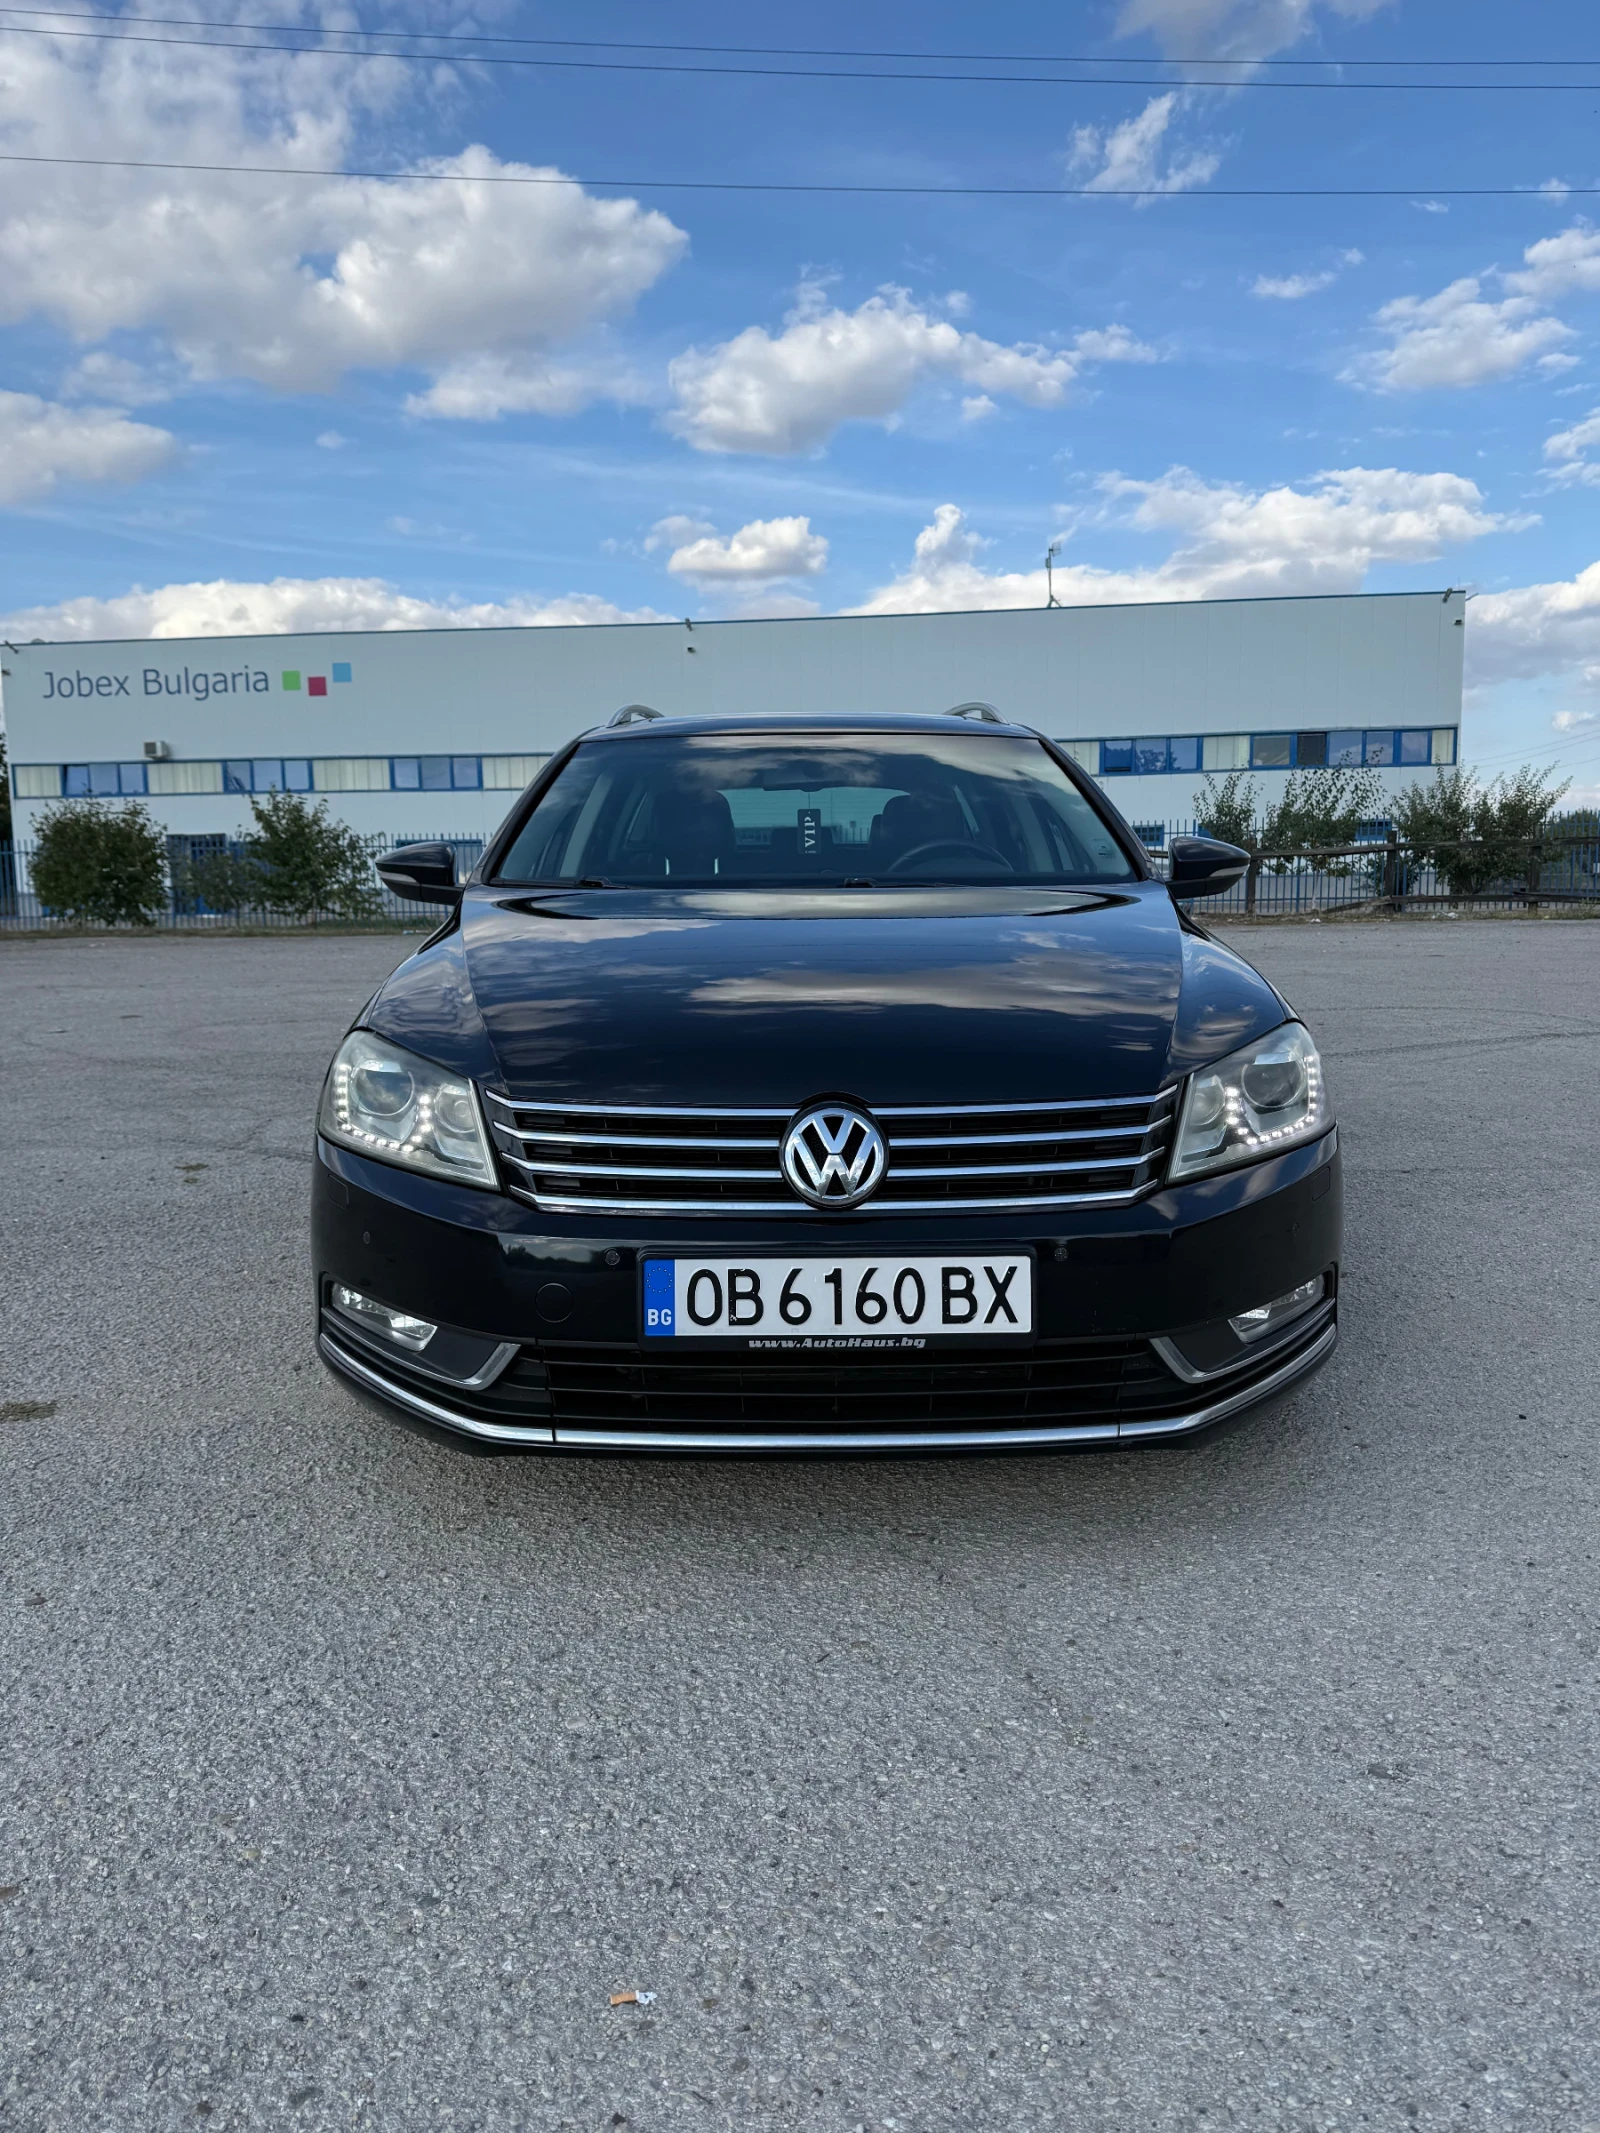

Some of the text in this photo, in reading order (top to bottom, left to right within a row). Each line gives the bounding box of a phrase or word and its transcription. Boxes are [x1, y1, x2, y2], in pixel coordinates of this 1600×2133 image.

[43, 666, 269, 700] Jobex Bulgaria
[804, 816, 816, 848] VIP
[785, 1108, 884, 1200] VW
[647, 1308, 672, 1326] BG
[748, 1336, 926, 1349] www.AutoHaus.bg
